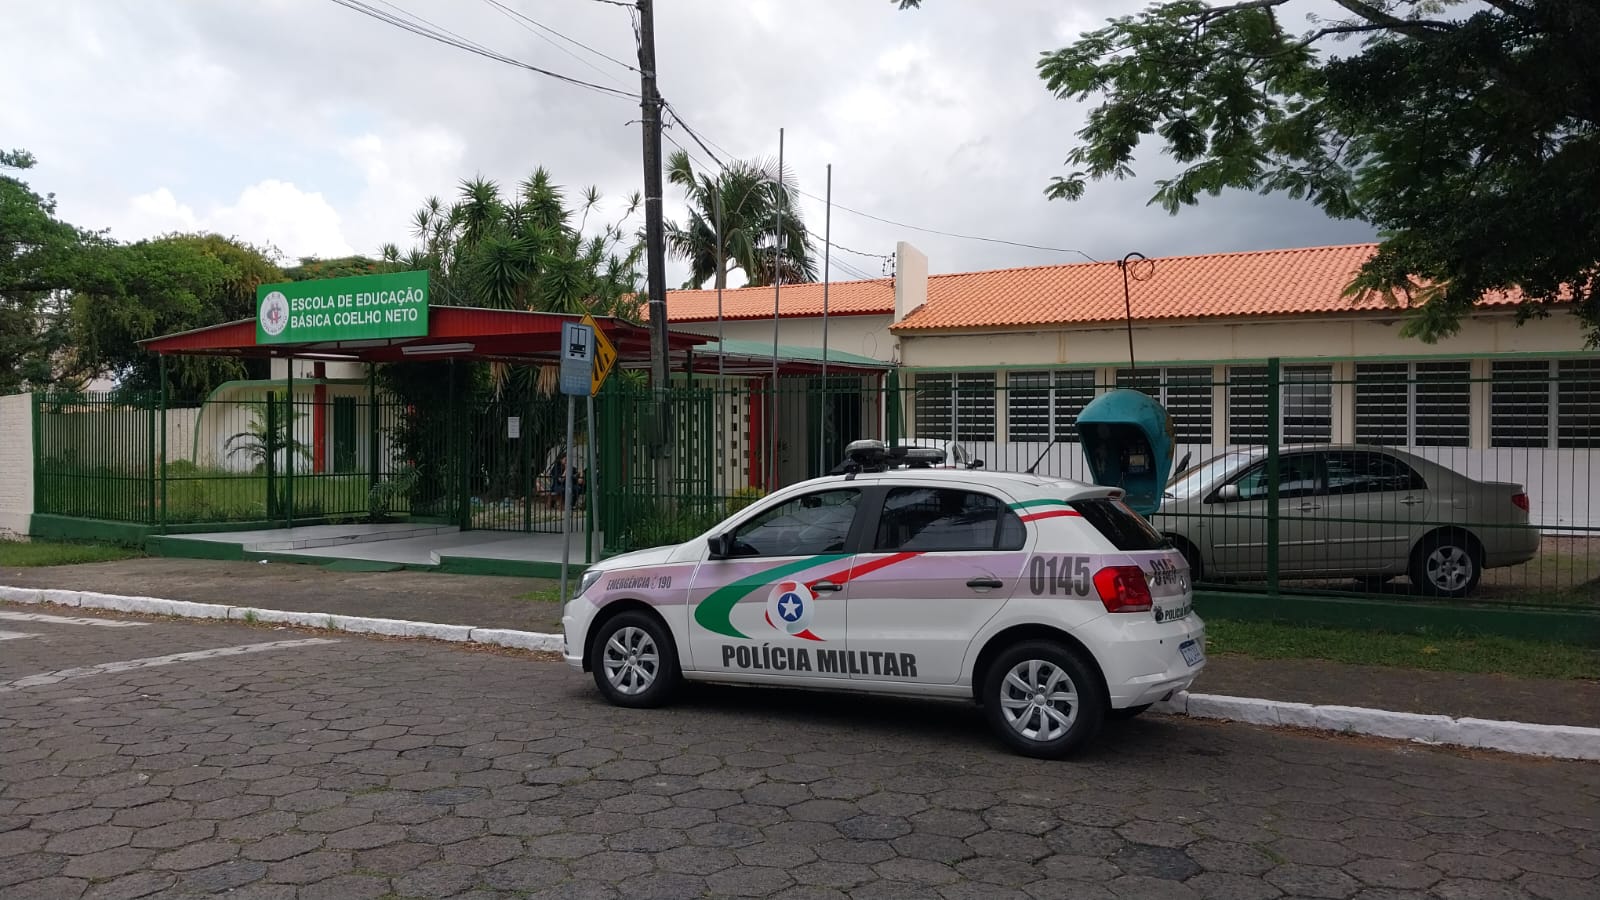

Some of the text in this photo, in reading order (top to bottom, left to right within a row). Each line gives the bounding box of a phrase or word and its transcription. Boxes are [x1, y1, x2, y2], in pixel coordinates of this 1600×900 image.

[291, 295, 335, 311] ESCOLA
[338, 294, 353, 308] DE
[356, 287, 424, 307] EDUCAÇÃO
[291, 313, 332, 328] BÁSICA
[333, 310, 382, 326] COELHO
[385, 307, 418, 323] NETO
[606, 575, 672, 591] EMERGÊNCIA 190
[1029, 555, 1091, 597] 0145
[721, 642, 918, 677] POLÍCIA MILITAR
